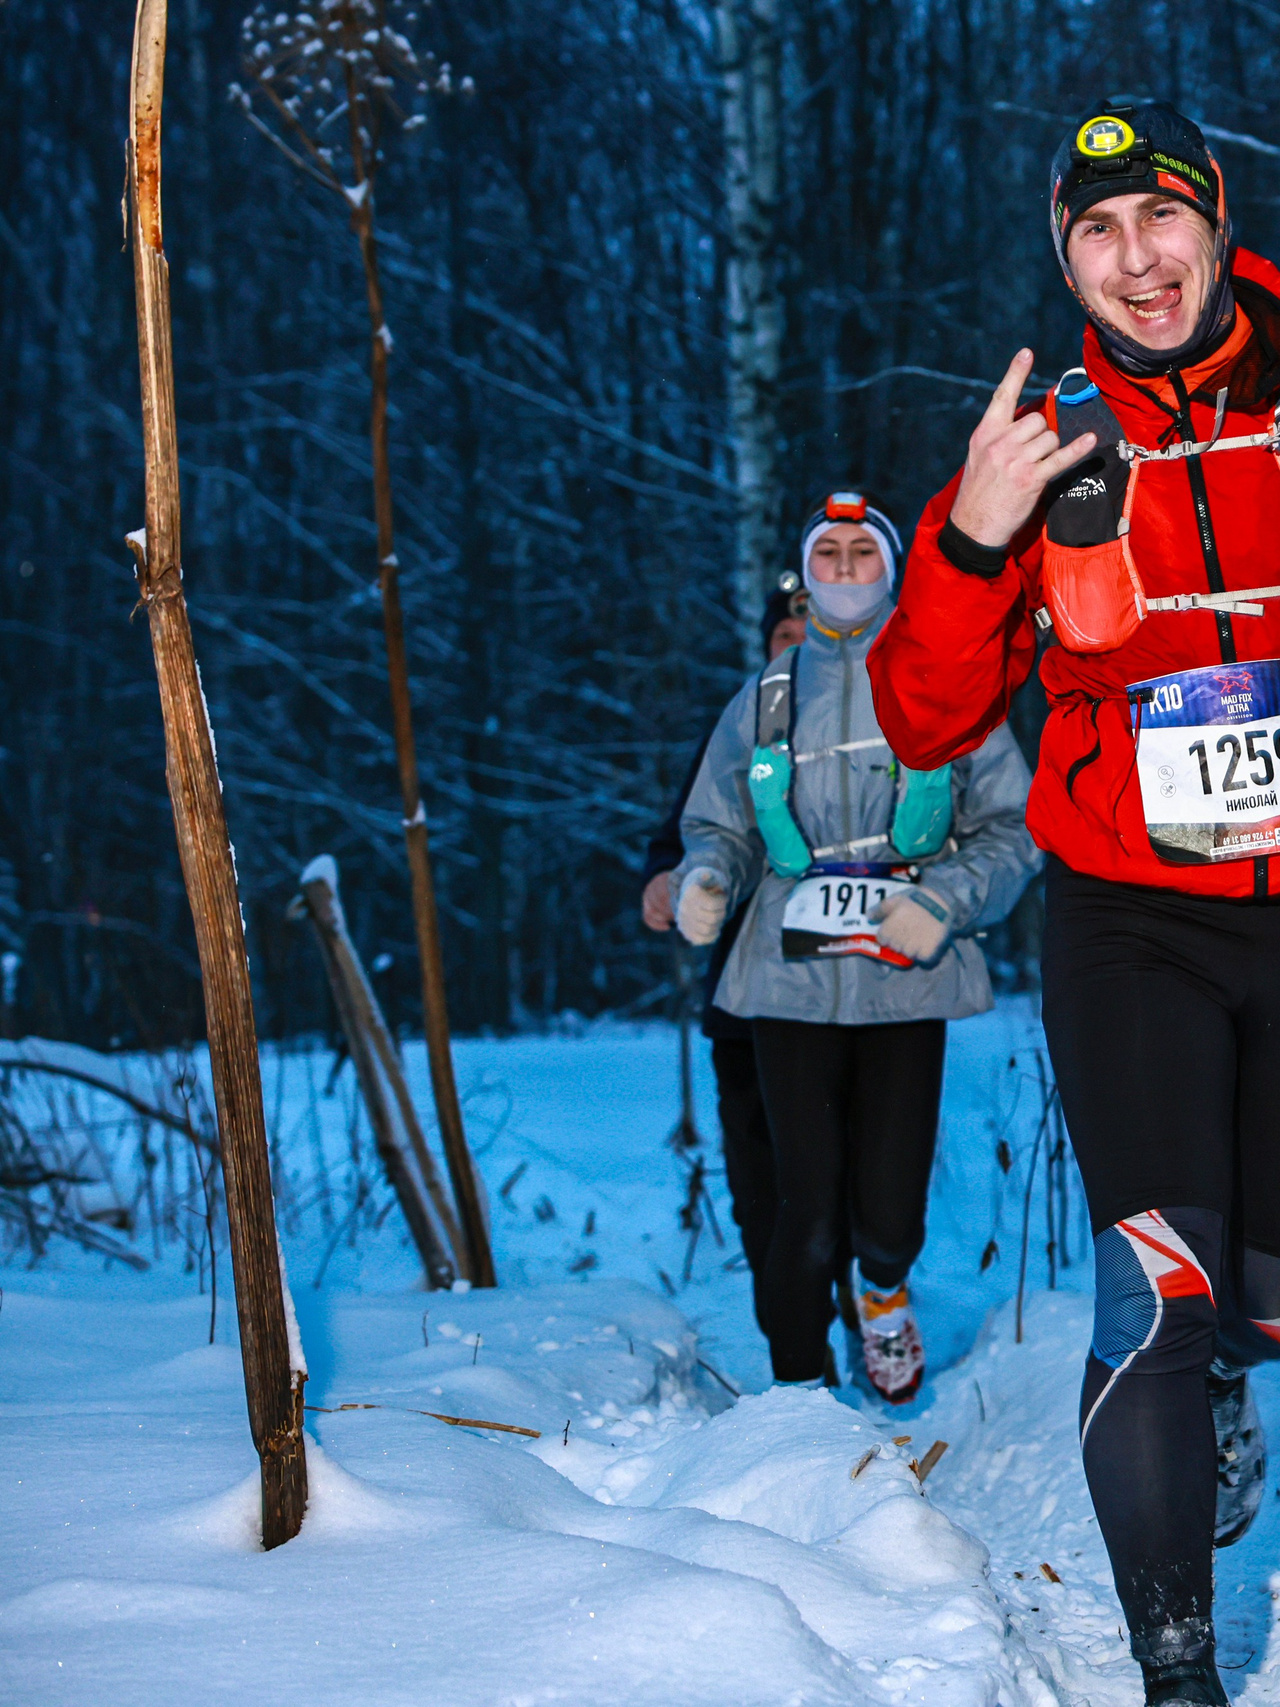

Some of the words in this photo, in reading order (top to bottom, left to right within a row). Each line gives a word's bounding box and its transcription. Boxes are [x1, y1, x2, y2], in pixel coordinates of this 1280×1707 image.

[1067, 488, 1098, 498] INOXTO
[1149, 683, 1183, 715] K10
[1220, 694, 1238, 706] MAD
[1238, 692, 1253, 703] FOX
[1227, 702, 1250, 714] ULTRA
[1226, 790, 1278, 812] НИКОЛАЙ
[1252, 832, 1264, 841] 926
